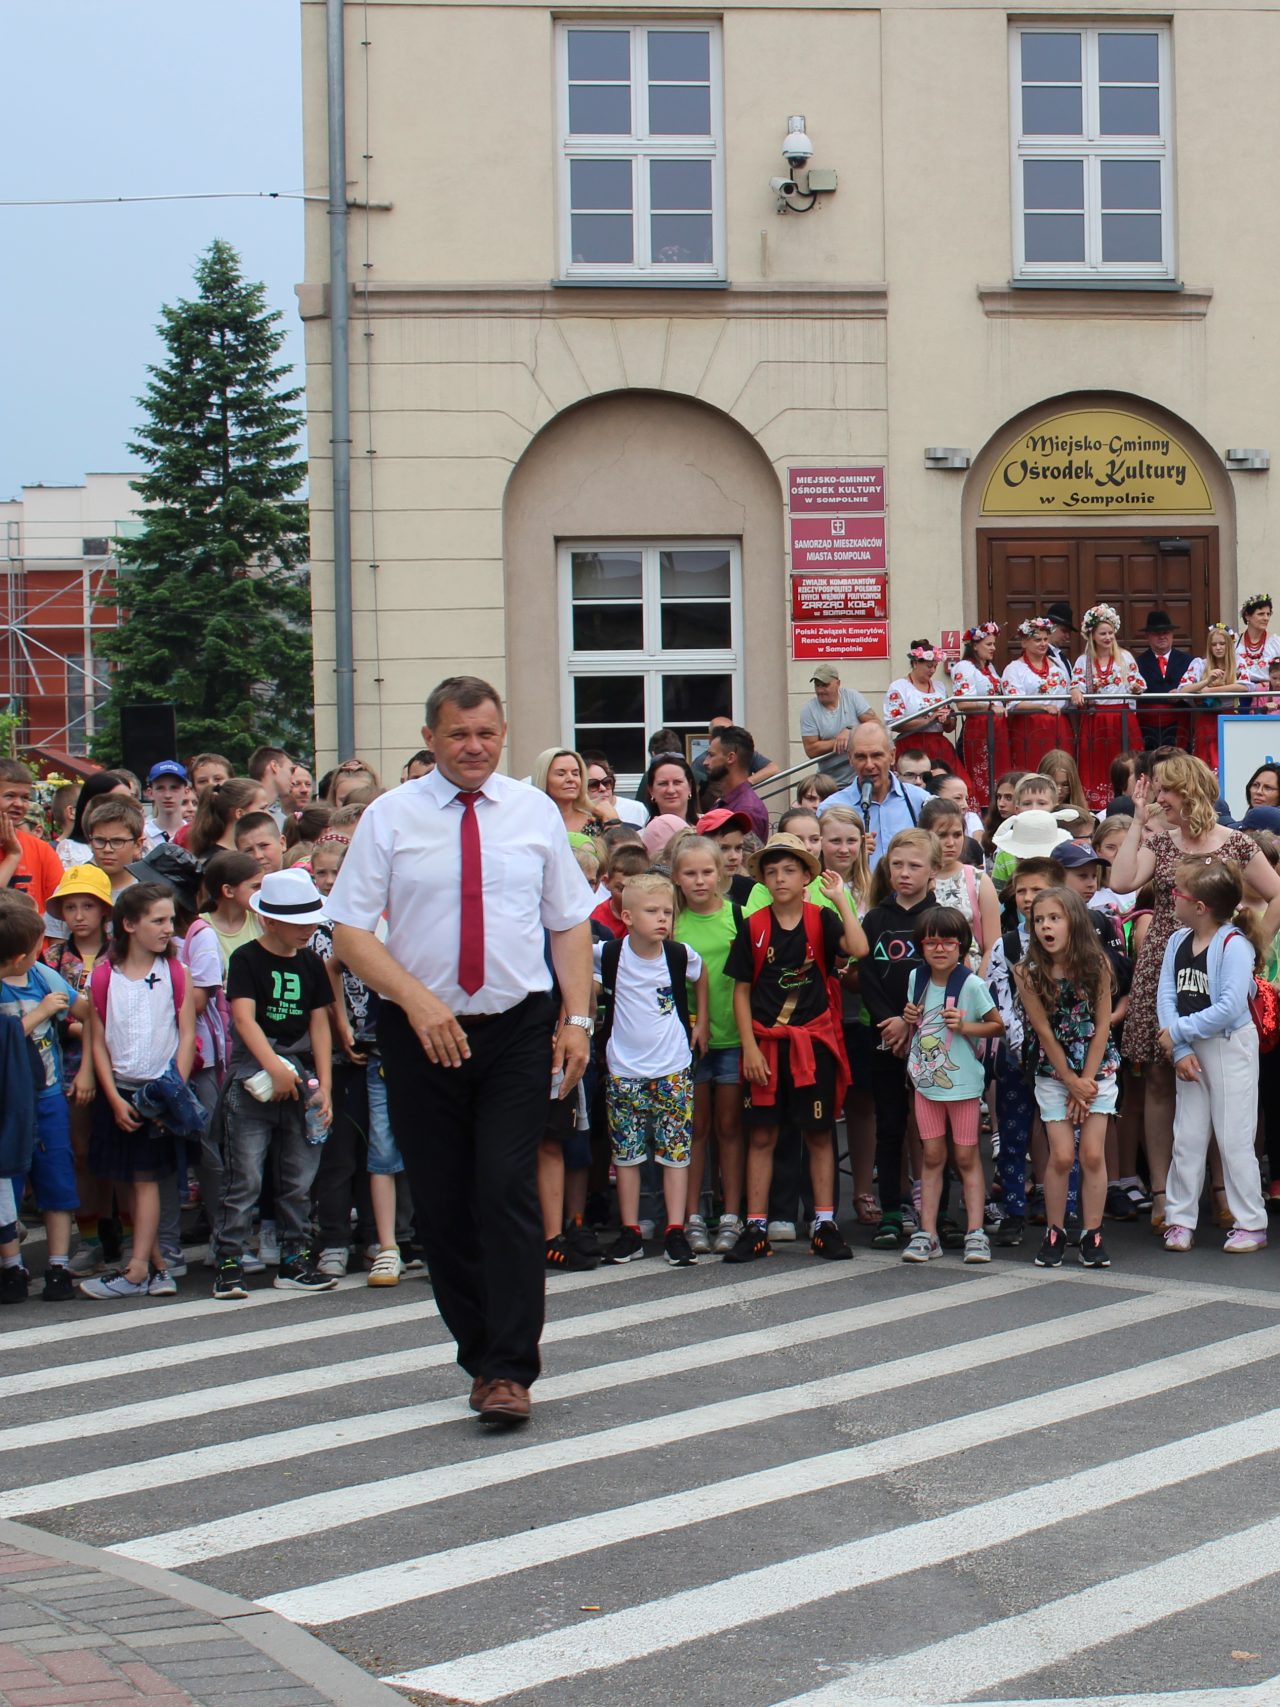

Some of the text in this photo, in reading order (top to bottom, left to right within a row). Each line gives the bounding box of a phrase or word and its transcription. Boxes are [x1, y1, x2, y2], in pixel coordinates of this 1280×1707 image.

[1026, 435, 1170, 457] Miejsko-Gminny
[1003, 459, 1187, 487] Ośrodek Kultury
[796, 475, 876, 484] MIEJSKO-GMINNY
[791, 484, 882, 494] OŚRODEK KULTURY
[1039, 492, 1155, 507] w Sompolnie
[794, 537, 883, 551] SAMORZĄD MIESZKAŃCÓW
[806, 551, 871, 561] MIASTA SOMPOLNA
[801, 600, 875, 609] ZARZĄD KOŁA
[818, 628, 847, 636] Związek
[825, 645, 863, 653] Sompolnie
[271, 970, 301, 1000] 13
